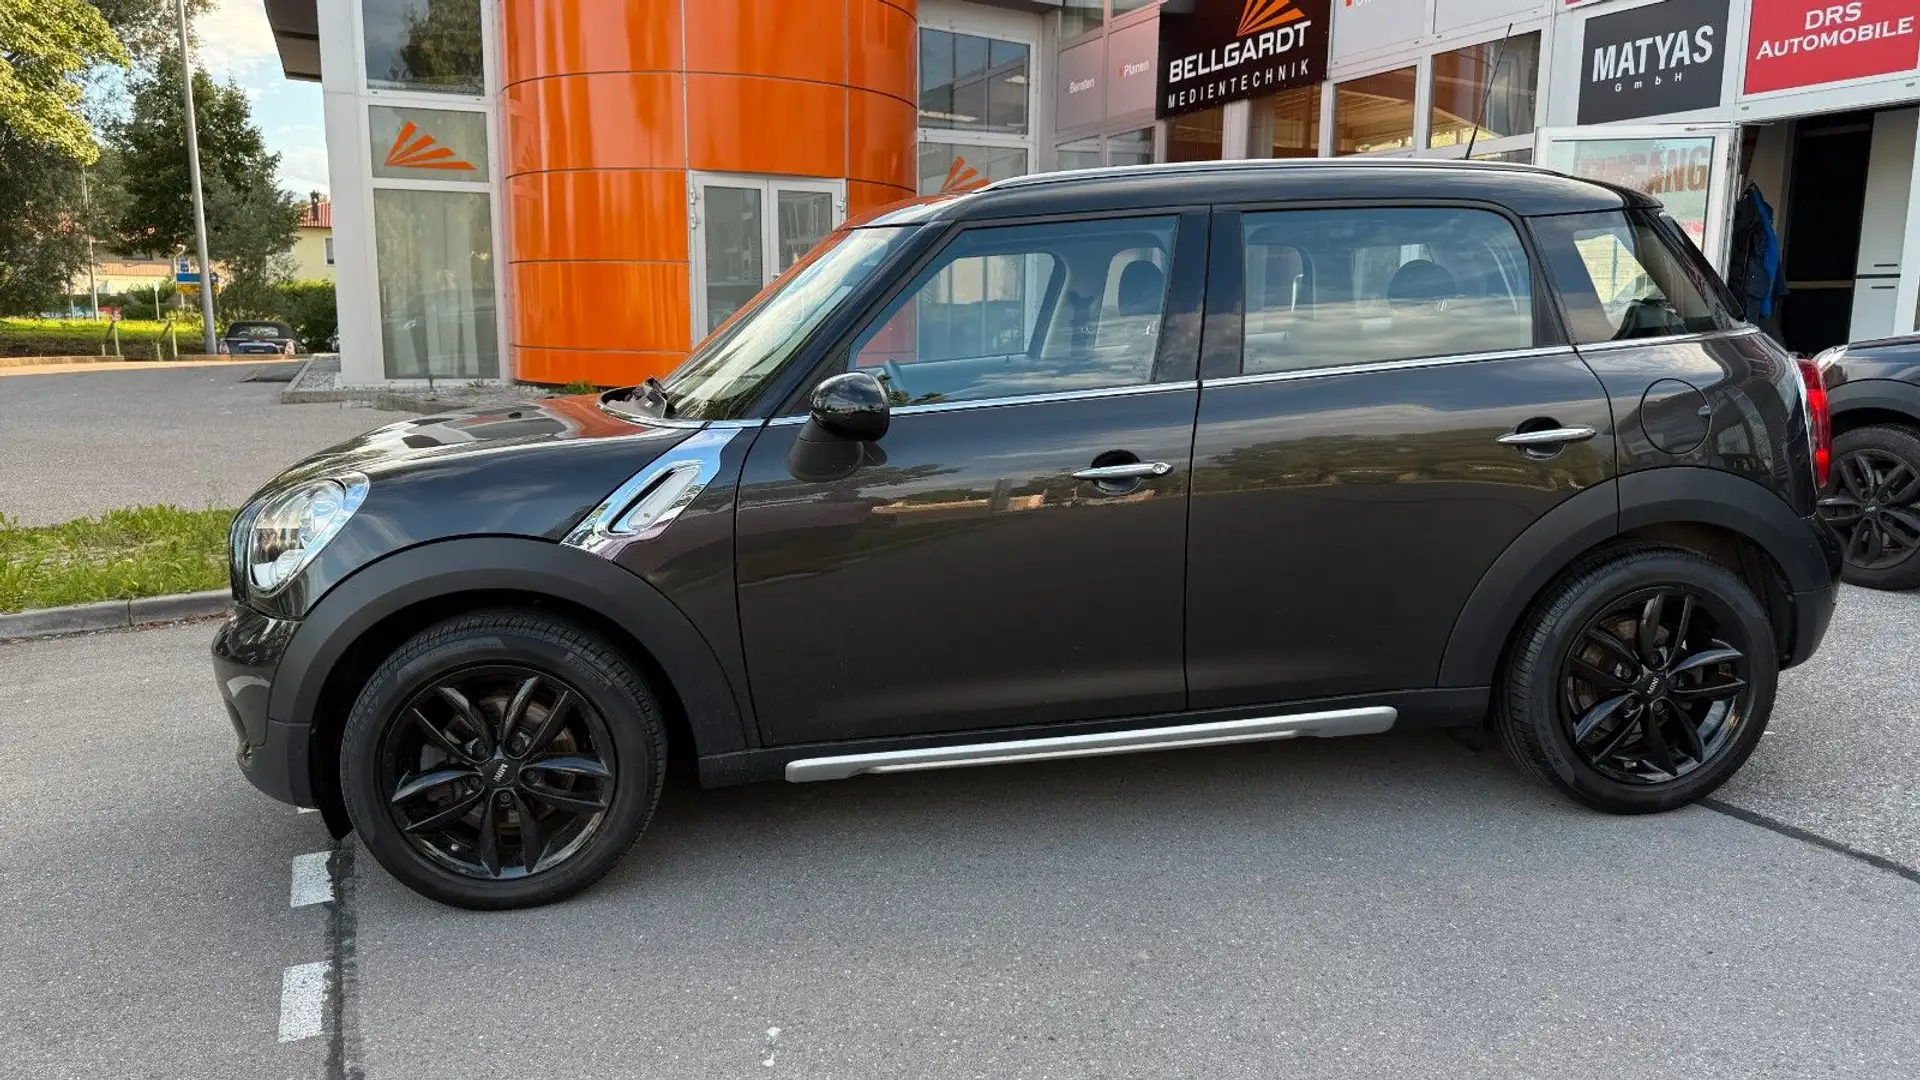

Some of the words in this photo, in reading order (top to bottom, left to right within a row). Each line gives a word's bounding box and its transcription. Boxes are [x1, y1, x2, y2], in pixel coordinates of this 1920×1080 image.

[1756, 16, 1914, 60] AUTOMOBILE
[1805, 1, 1863, 30] DRS
[1124, 60, 1150, 77] Planen
[1169, 20, 1311, 83] BELLGARDT
[1592, 25, 1714, 82] MATYAS
[1168, 58, 1310, 109] MEDIENTECHNIK
